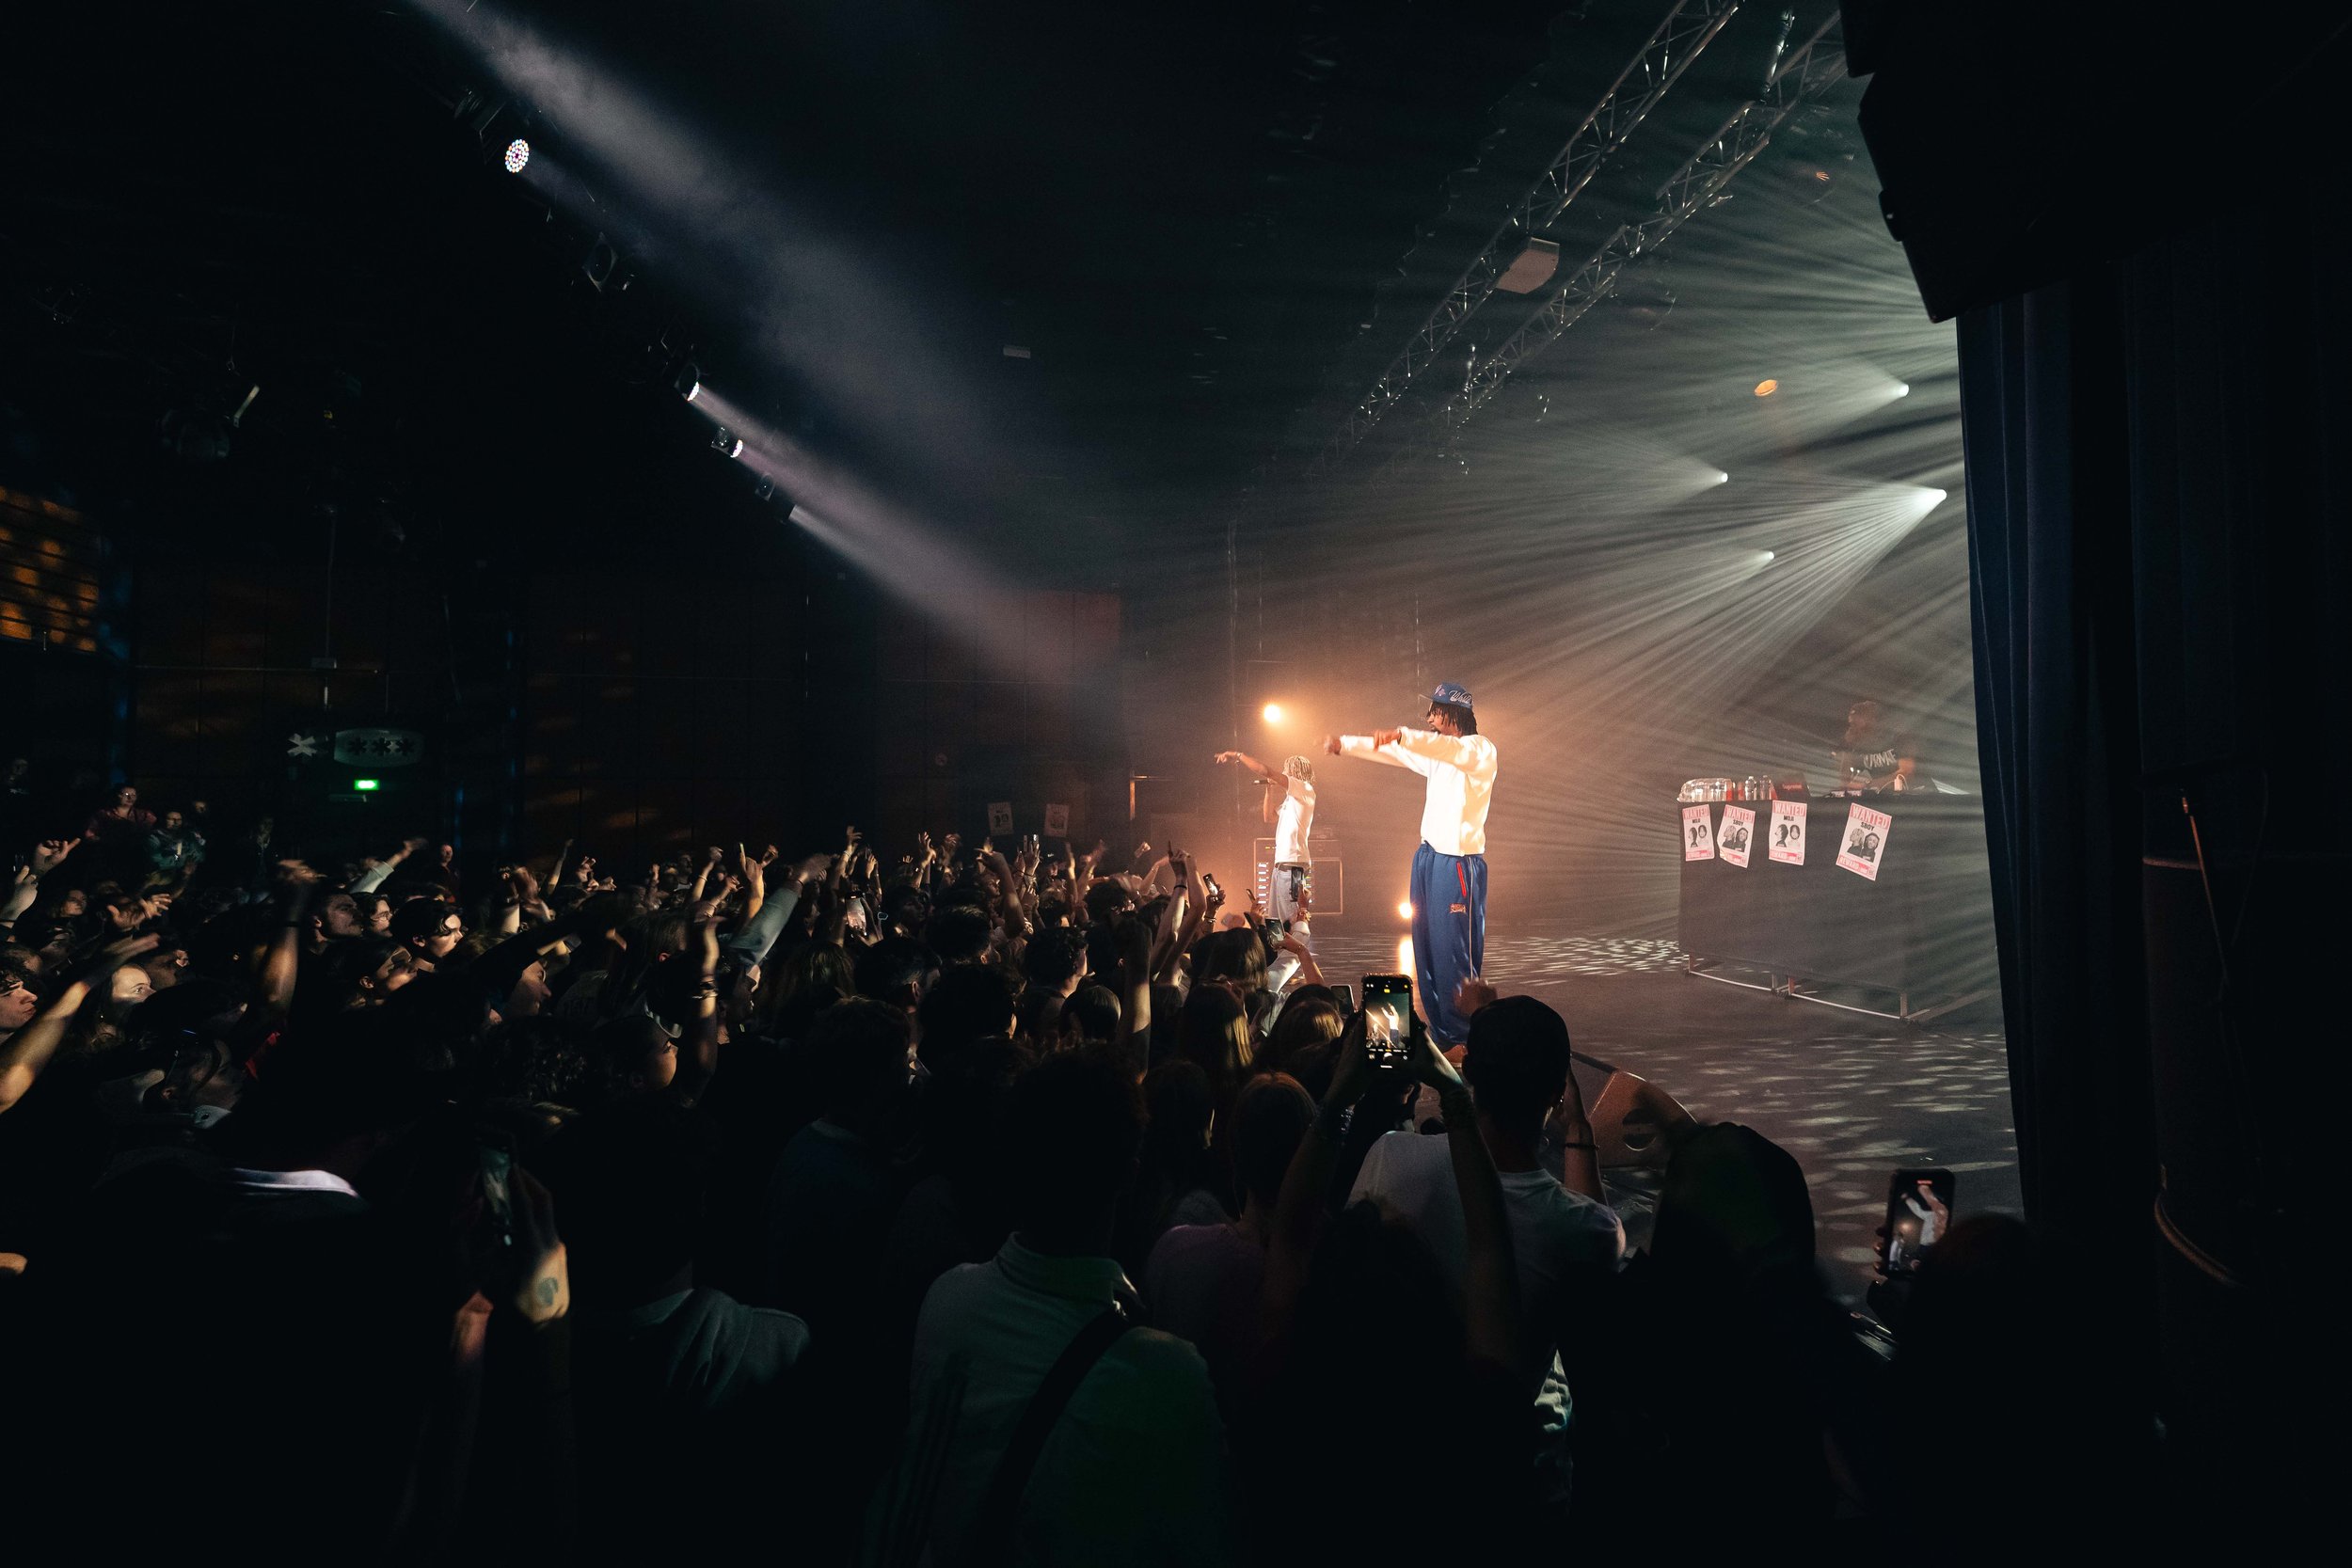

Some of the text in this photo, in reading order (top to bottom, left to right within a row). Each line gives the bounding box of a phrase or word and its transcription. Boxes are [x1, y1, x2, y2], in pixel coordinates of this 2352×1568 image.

[1683, 805, 1708, 819] WANTED
[1724, 805, 1755, 823] WANTED
[1773, 801, 1805, 816] WANTED
[1851, 805, 1889, 828] WANTED
[1860, 821, 1875, 832] SBOY
